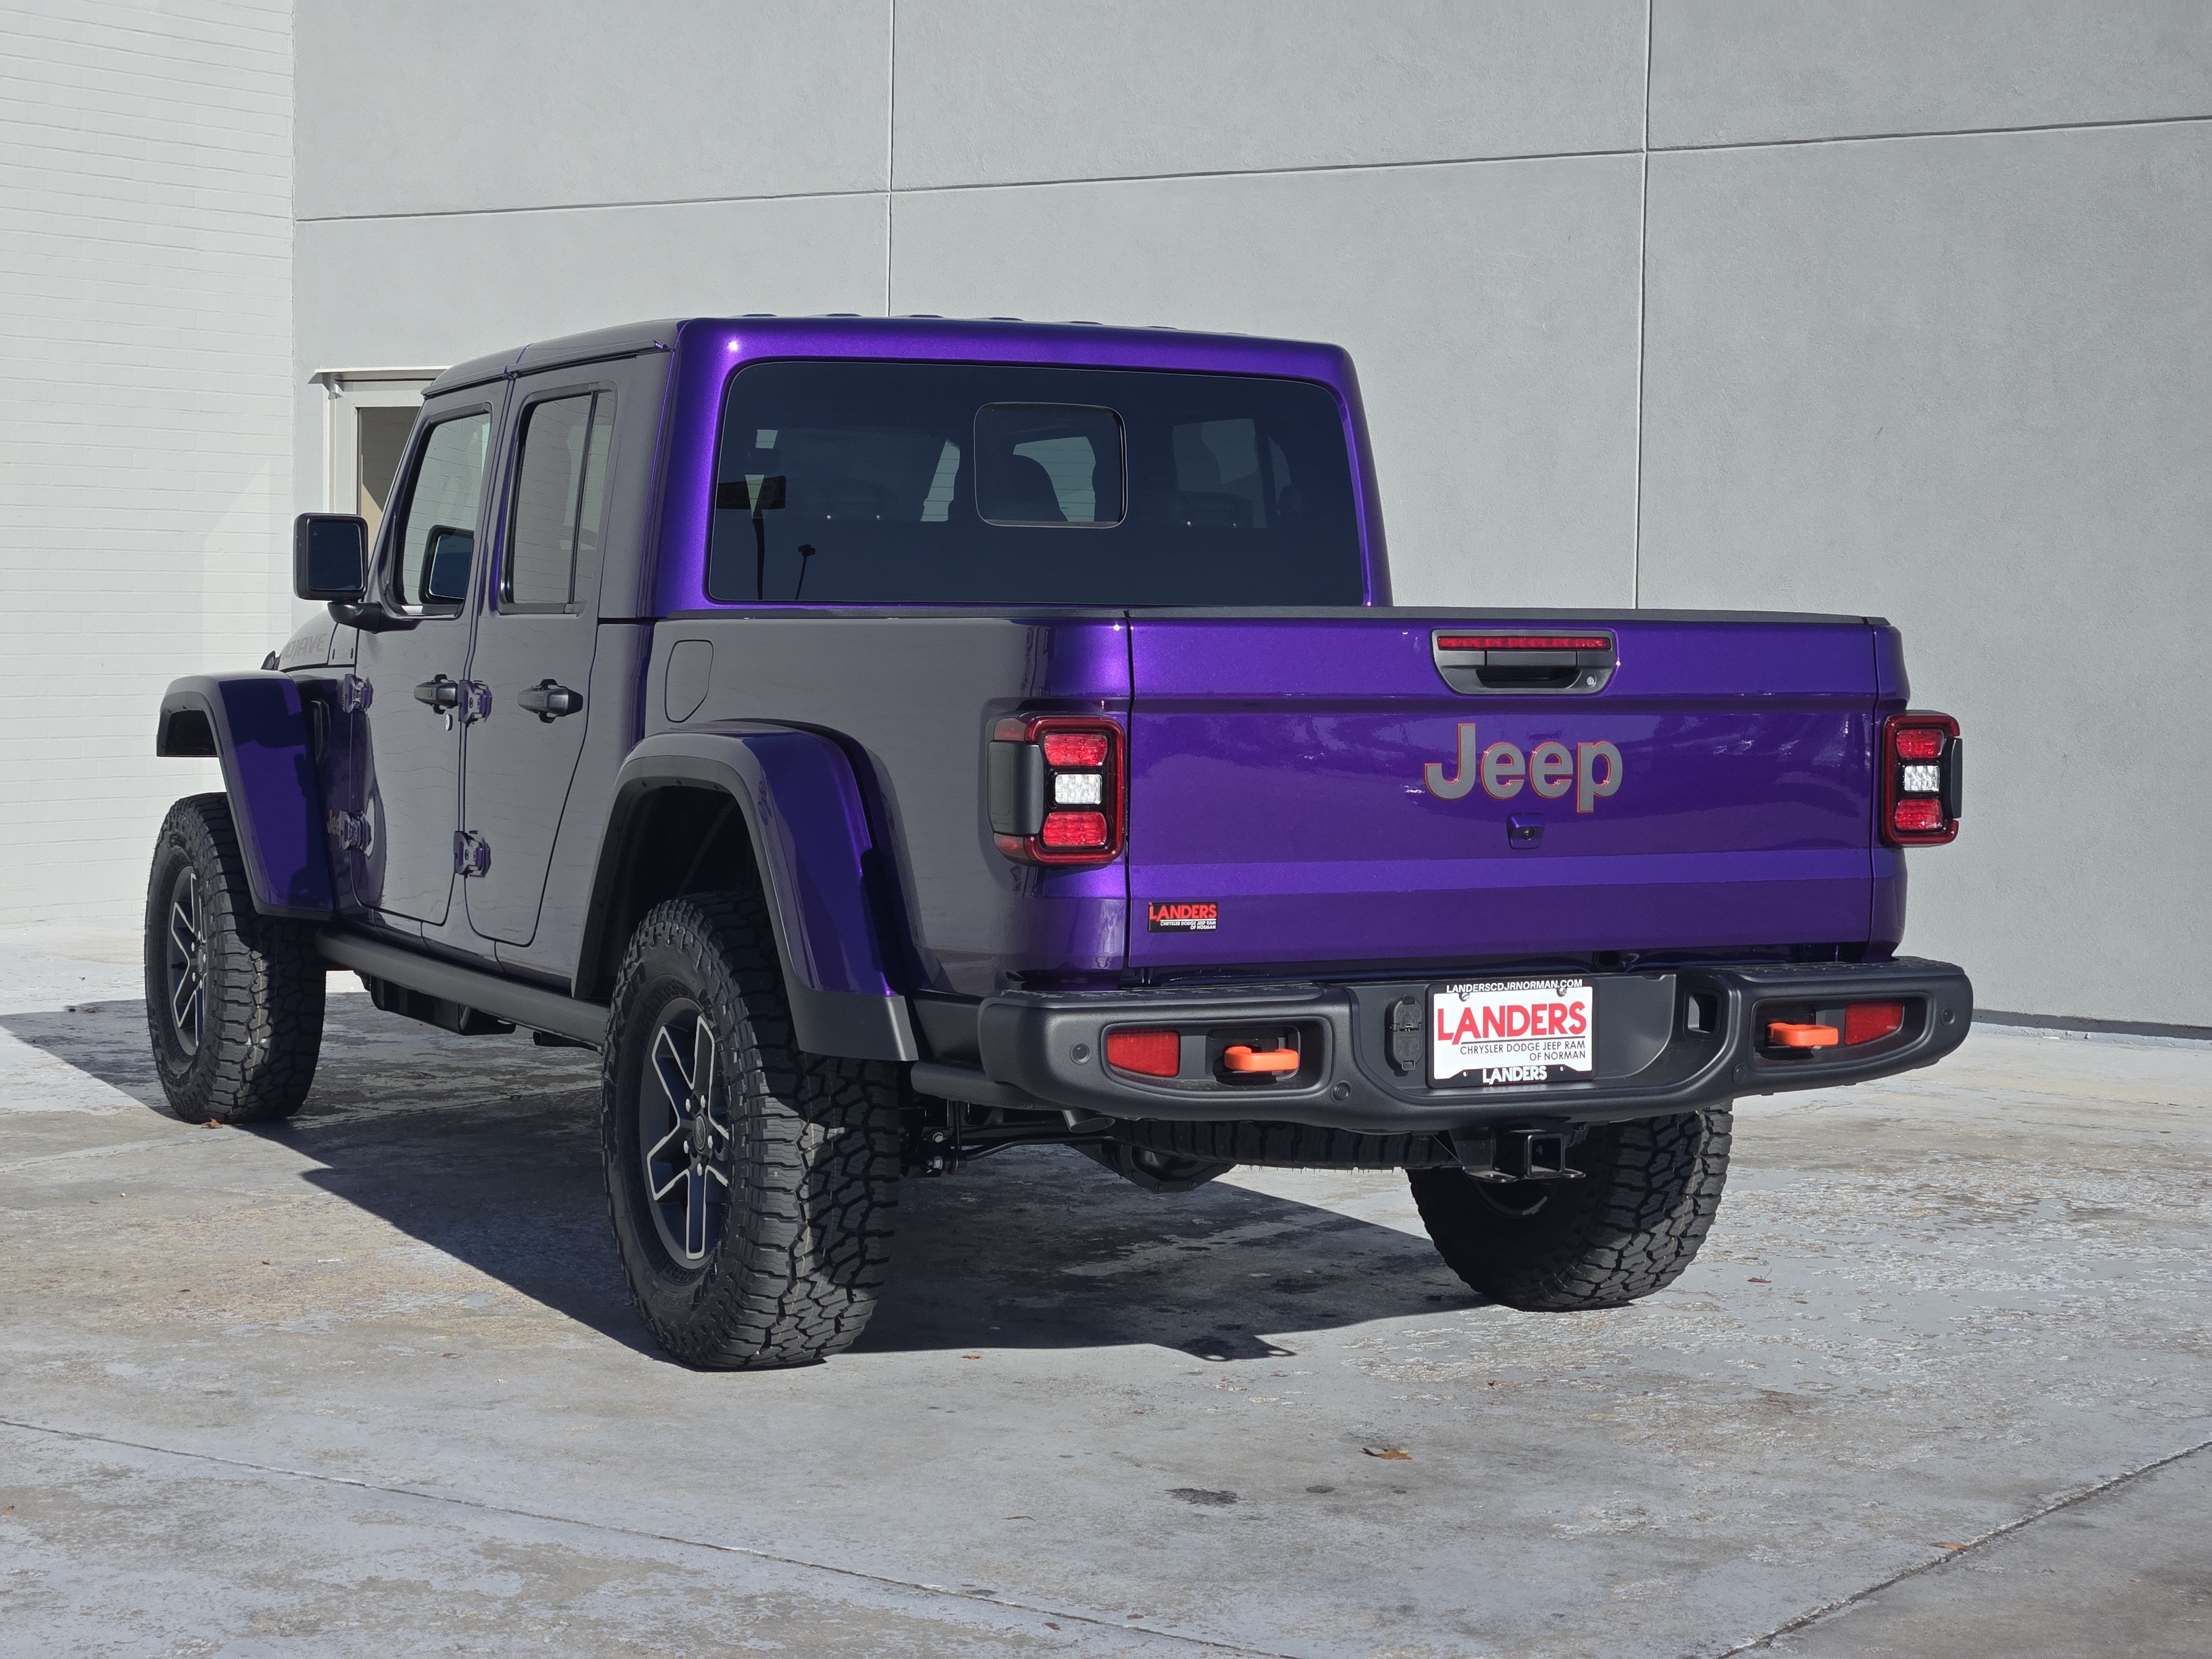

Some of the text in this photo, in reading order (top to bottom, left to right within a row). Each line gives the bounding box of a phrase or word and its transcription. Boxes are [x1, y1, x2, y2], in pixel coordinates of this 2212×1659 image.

[1425, 723, 1623, 813] Jeep
[1150, 904, 1217, 921] LANDERS
[1446, 979, 1583, 993] LANDERSCDJRNORMAN.COM
[1438, 1001, 1587, 1045] LANDERS
[1460, 1040, 1585, 1055] CHRYSLER DODGE JEEP RAM
[1530, 1050, 1585, 1061] OF NORMAN
[1483, 1065, 1547, 1085] LANDERS
